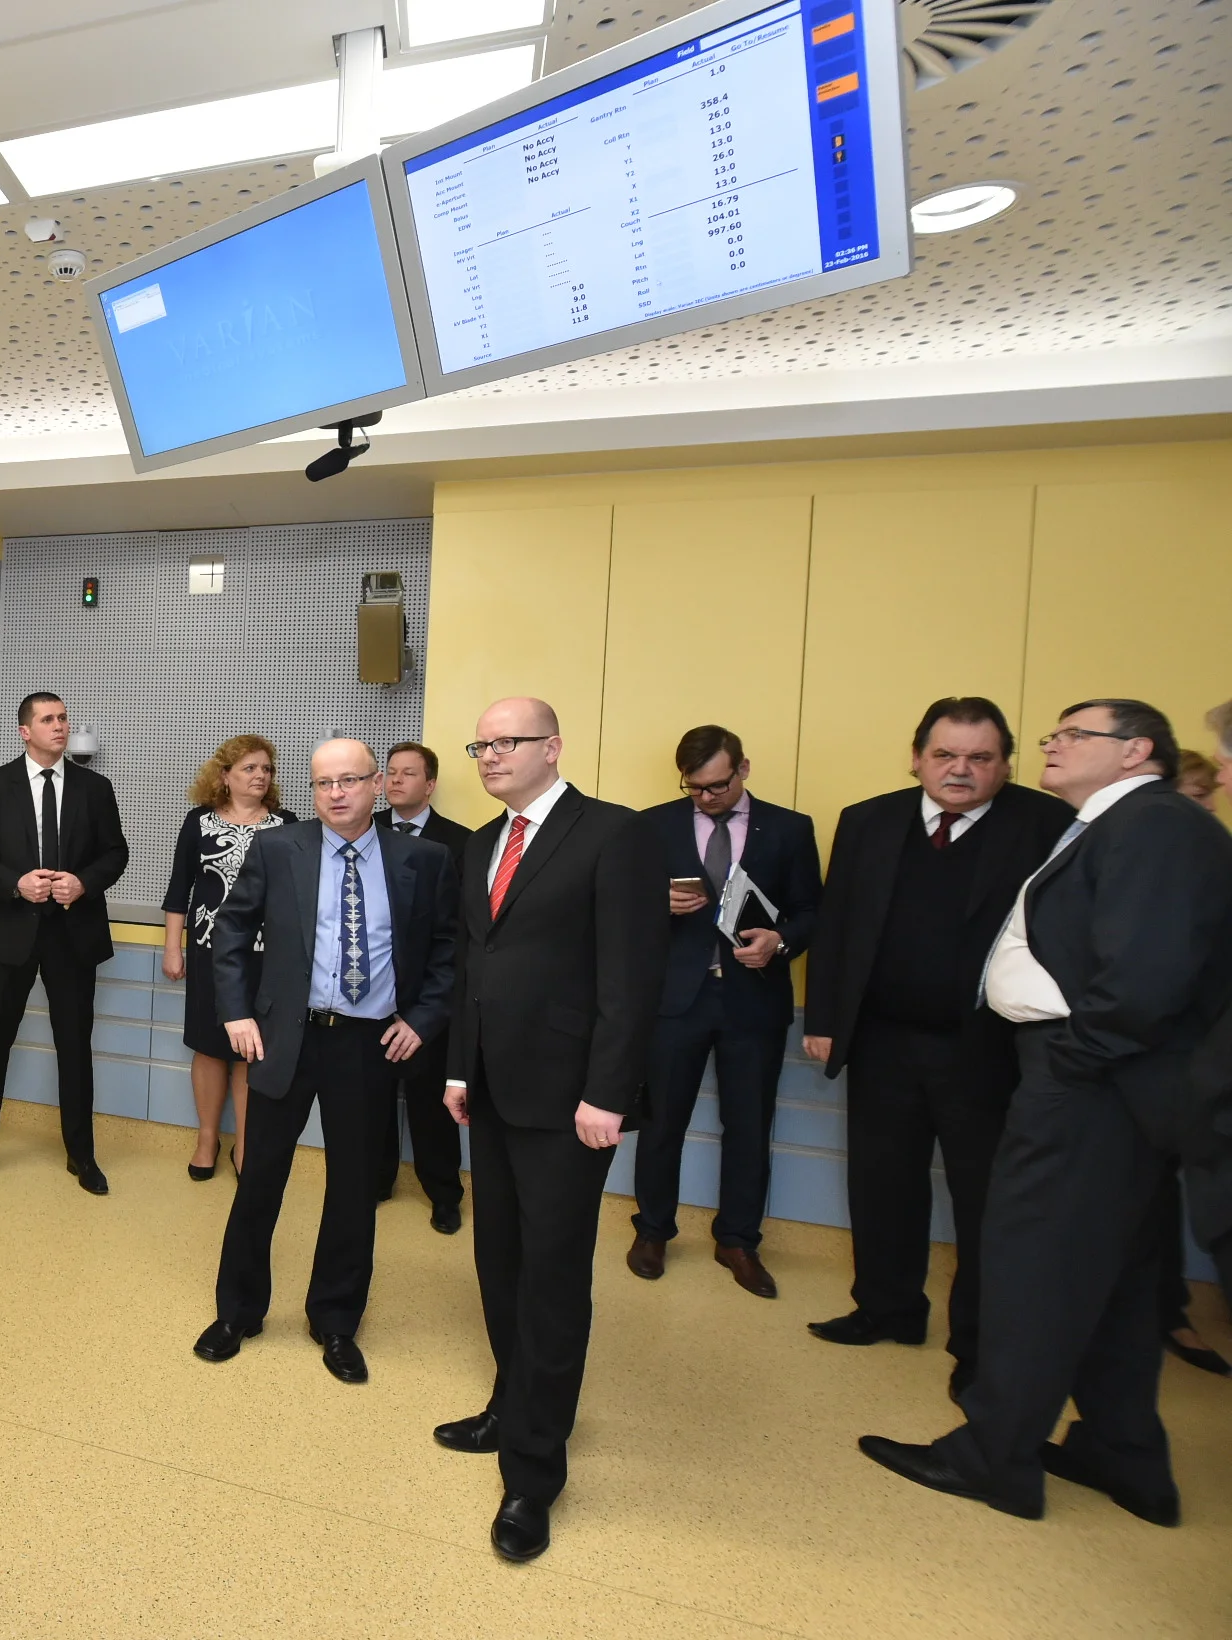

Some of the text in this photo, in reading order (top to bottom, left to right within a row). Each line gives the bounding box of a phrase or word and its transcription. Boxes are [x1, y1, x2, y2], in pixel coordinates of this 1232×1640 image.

[643, 24, 789, 87] Plan Actual Go To/Resume
[677, 45, 695, 59] Field
[710, 65, 726, 76] 1.0
[701, 93, 729, 110] 358.4
[590, 105, 627, 123] Gantry Rtn
[708, 107, 730, 121] 26.0
[710, 121, 731, 135] 13.0
[483, 118, 557, 152] Plan Actual
[711, 135, 733, 148] 13.0
[523, 135, 555, 151] No Accy
[525, 146, 557, 162] No Accy
[713, 149, 734, 162] 26.0
[527, 157, 558, 173] No Accy
[715, 163, 736, 175] 13.0
[445, 171, 463, 181] Mount
[528, 168, 560, 184] No Accy
[716, 176, 737, 188] 13.0
[447, 182, 464, 192] Mount
[712, 195, 739, 209] 16.79
[497, 208, 570, 237] Plan Actual
[707, 208, 740, 224] 104.01
[621, 218, 640, 228] Couch
[708, 222, 742, 237] 997.60
[632, 239, 643, 247] Lng
[728, 235, 743, 244] 0.0
[729, 248, 744, 257] 0.0
[731, 261, 746, 270] 0.0
[632, 276, 648, 285] Pitch
[572, 284, 584, 292] 9.0
[638, 288, 649, 296] Roll
[573, 294, 586, 302] 9.0
[571, 304, 587, 314] 11.8
[572, 314, 589, 324] 11.8
